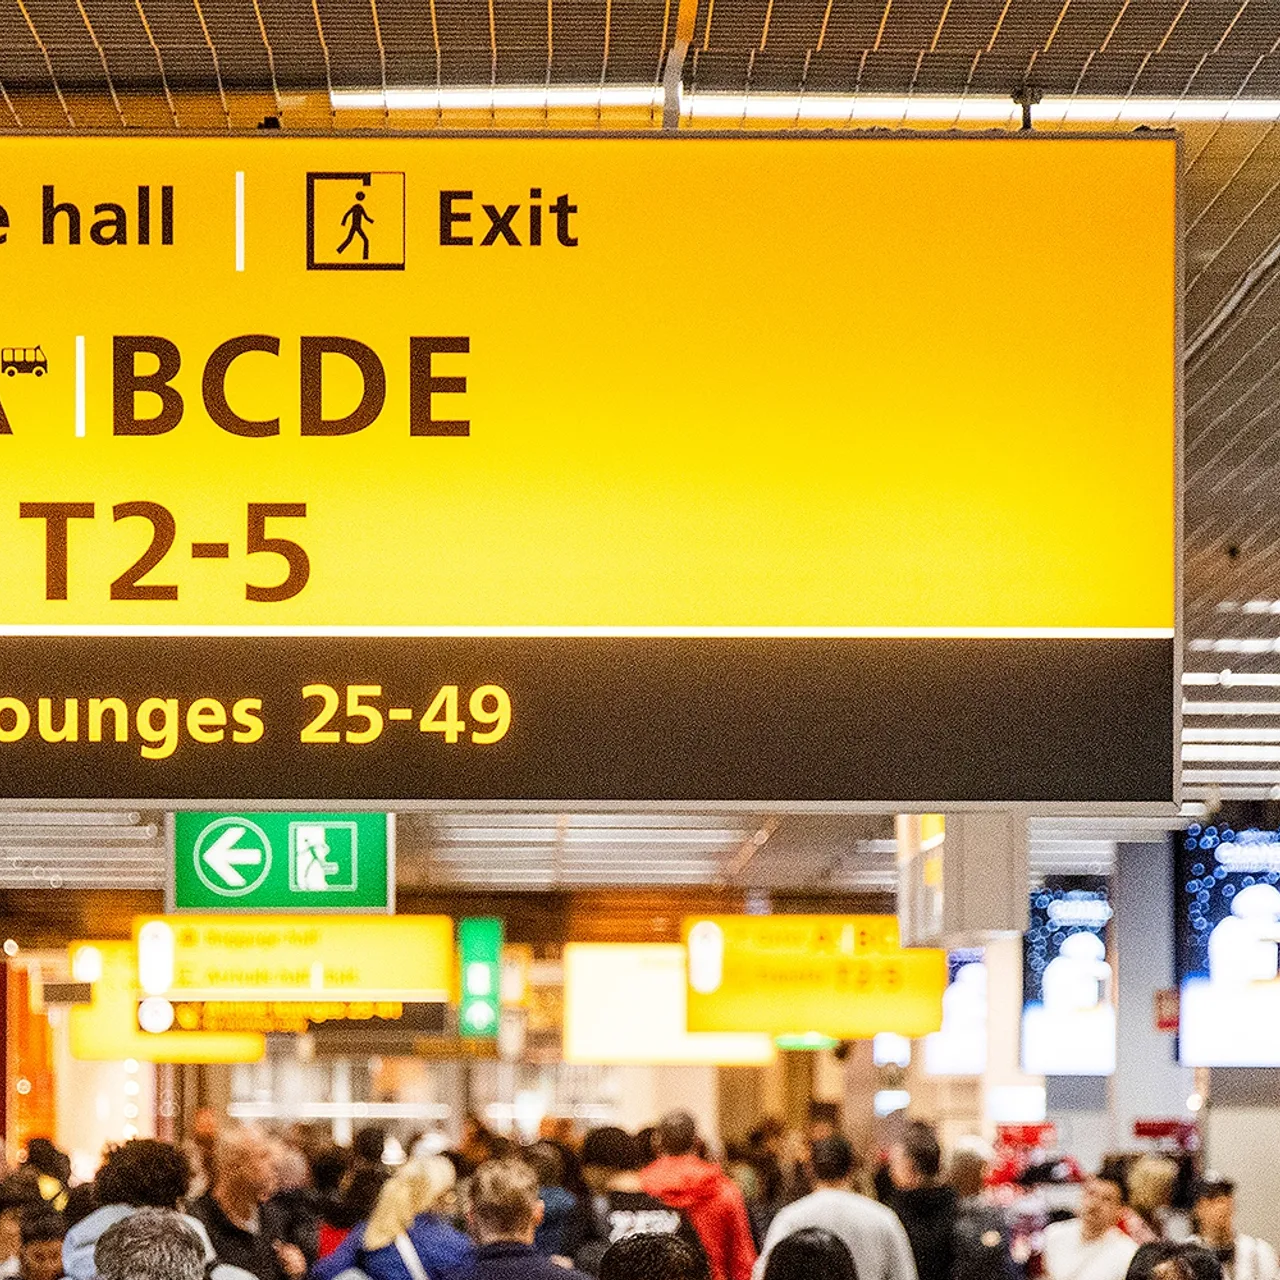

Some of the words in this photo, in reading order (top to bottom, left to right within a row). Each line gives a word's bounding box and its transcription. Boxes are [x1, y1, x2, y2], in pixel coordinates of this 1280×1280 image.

[43, 185, 173, 245] hall
[440, 188, 578, 247] Exit
[113, 334, 470, 437] BCDE
[20, 501, 310, 602] T2-5
[300, 678, 513, 745] 25-49
